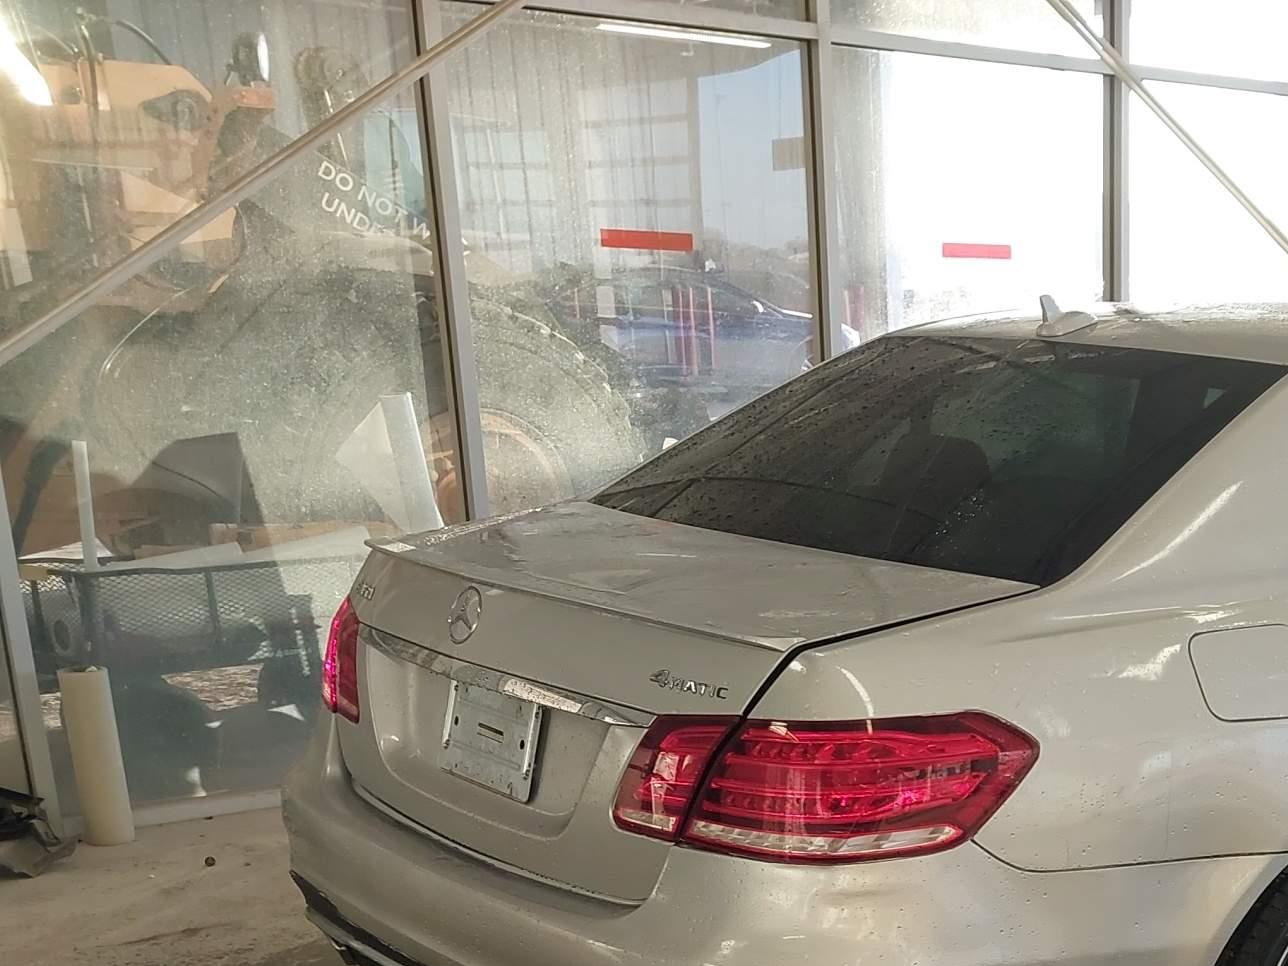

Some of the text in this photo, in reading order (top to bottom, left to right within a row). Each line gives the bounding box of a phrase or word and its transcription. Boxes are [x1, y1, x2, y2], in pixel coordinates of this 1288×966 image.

[318, 160, 408, 223] DO NOT
[648, 668, 729, 700] 4MATIC
